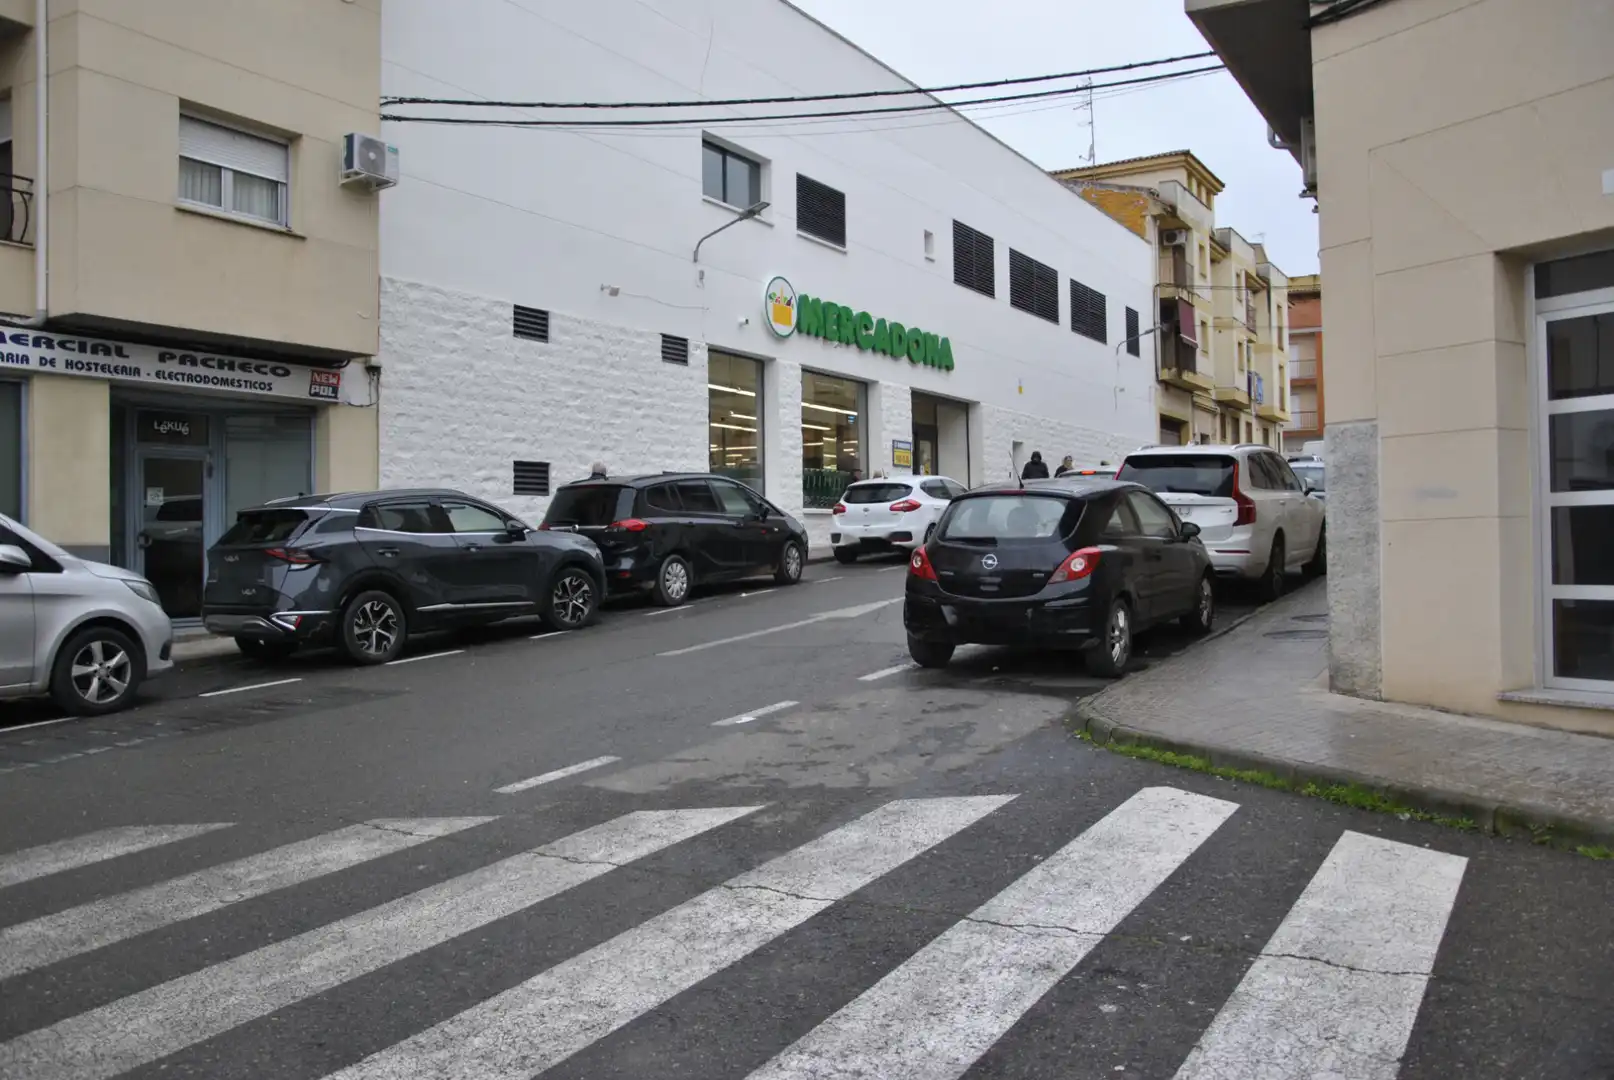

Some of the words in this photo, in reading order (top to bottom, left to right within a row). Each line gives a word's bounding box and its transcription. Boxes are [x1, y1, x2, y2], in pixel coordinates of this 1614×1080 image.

[796, 293, 954, 371] MERCADONA
[39, 356, 56, 368] DE
[65, 359, 141, 377] HOSTELERIA
[155, 369, 273, 391] ELECTRODOMESTICOS
[158, 351, 291, 378] PACHECO
[312, 371, 338, 385] NEW
[311, 384, 336, 397] POL
